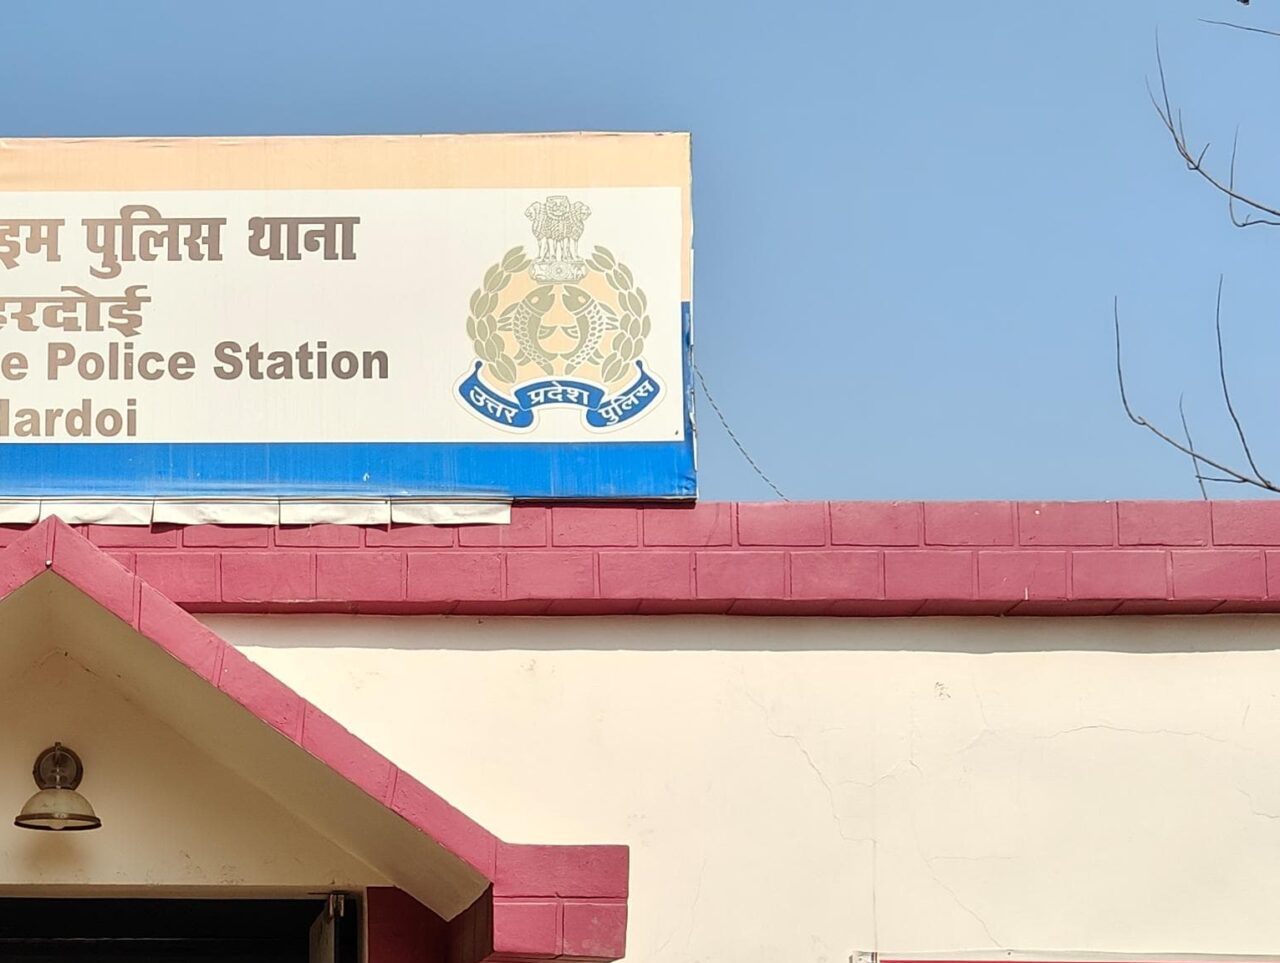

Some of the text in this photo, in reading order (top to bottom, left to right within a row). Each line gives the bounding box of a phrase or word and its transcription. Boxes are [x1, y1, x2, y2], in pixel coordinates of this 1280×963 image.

[81, 204, 226, 280] पुलिस
[247, 216, 360, 262] थाना
[46, 341, 196, 381] Police
[213, 340, 389, 381] Station
[470, 380, 654, 425] उत्तर प्रदेश पुलिस
